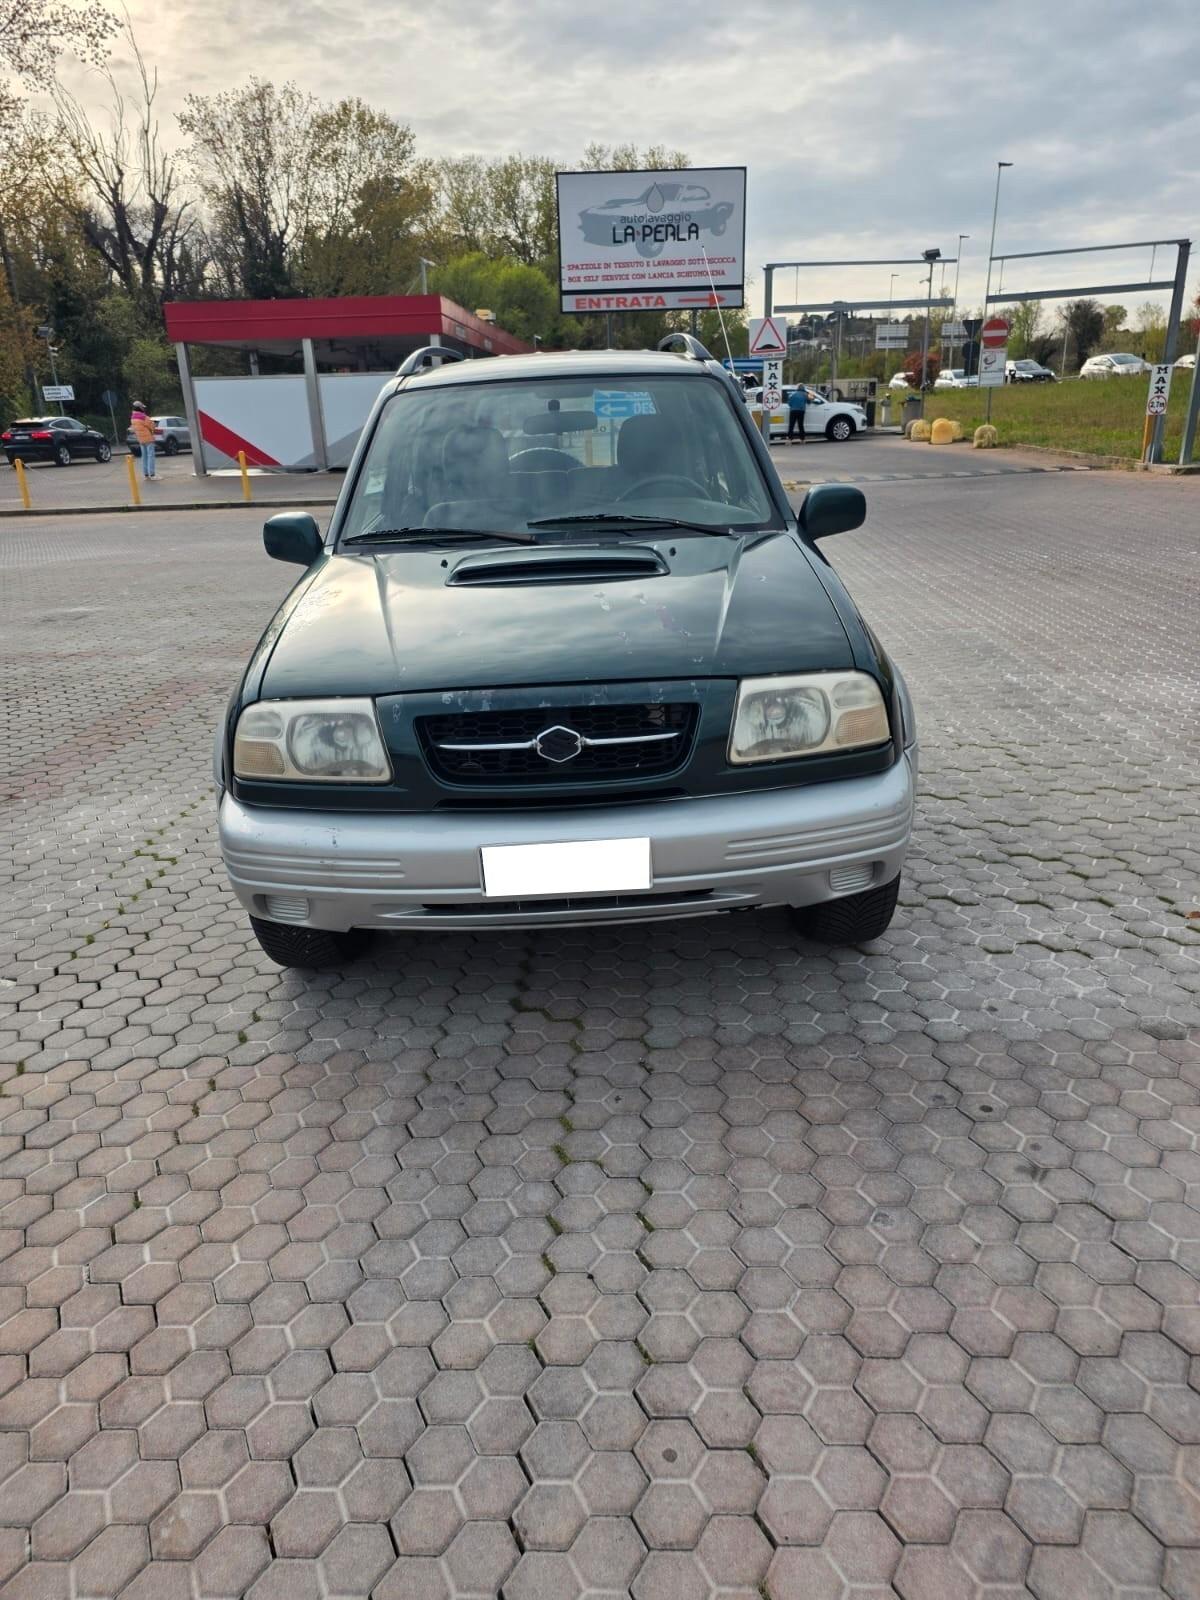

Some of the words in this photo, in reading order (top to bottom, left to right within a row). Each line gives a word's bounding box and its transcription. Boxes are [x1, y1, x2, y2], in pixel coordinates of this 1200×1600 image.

[620, 213, 692, 224] autolavaggio
[612, 225, 635, 244] LA
[642, 223, 699, 243] PERLA
[653, 259, 686, 267] LAVAGGIO
[575, 295, 667, 310] ENTRATA
[768, 362, 778, 390] MAX
[1154, 366, 1168, 394] MAX
